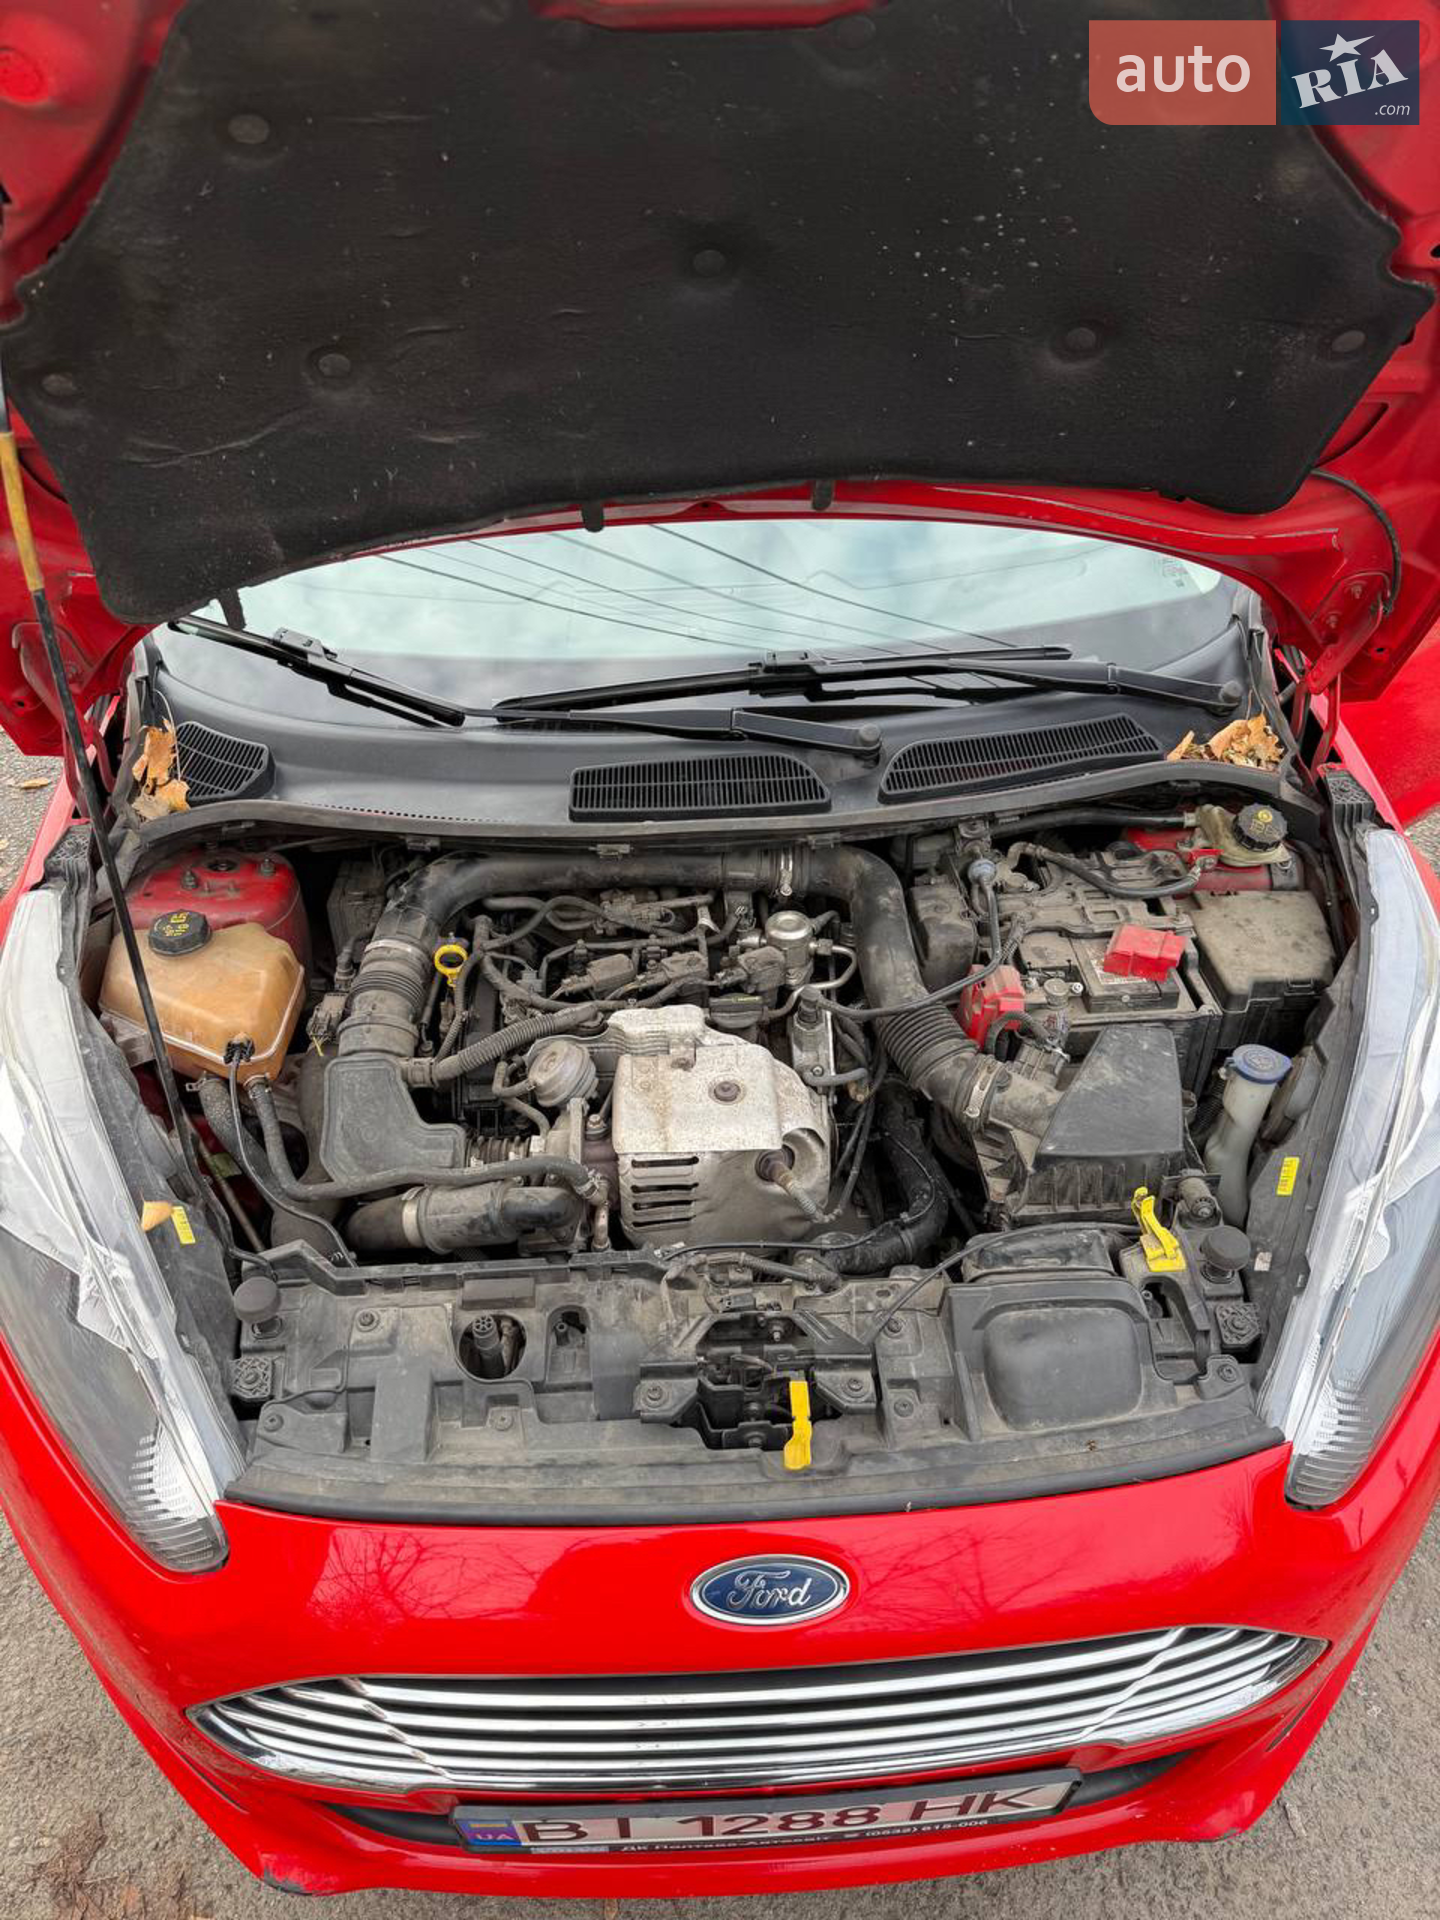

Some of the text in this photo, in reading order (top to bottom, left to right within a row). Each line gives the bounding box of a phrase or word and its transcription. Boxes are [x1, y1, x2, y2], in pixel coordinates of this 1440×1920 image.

[726, 1569, 812, 1610] Ford
[474, 1833, 514, 1841] UA
[677, 1806, 881, 1837] 1288
[909, 1785, 1046, 1821] HK
